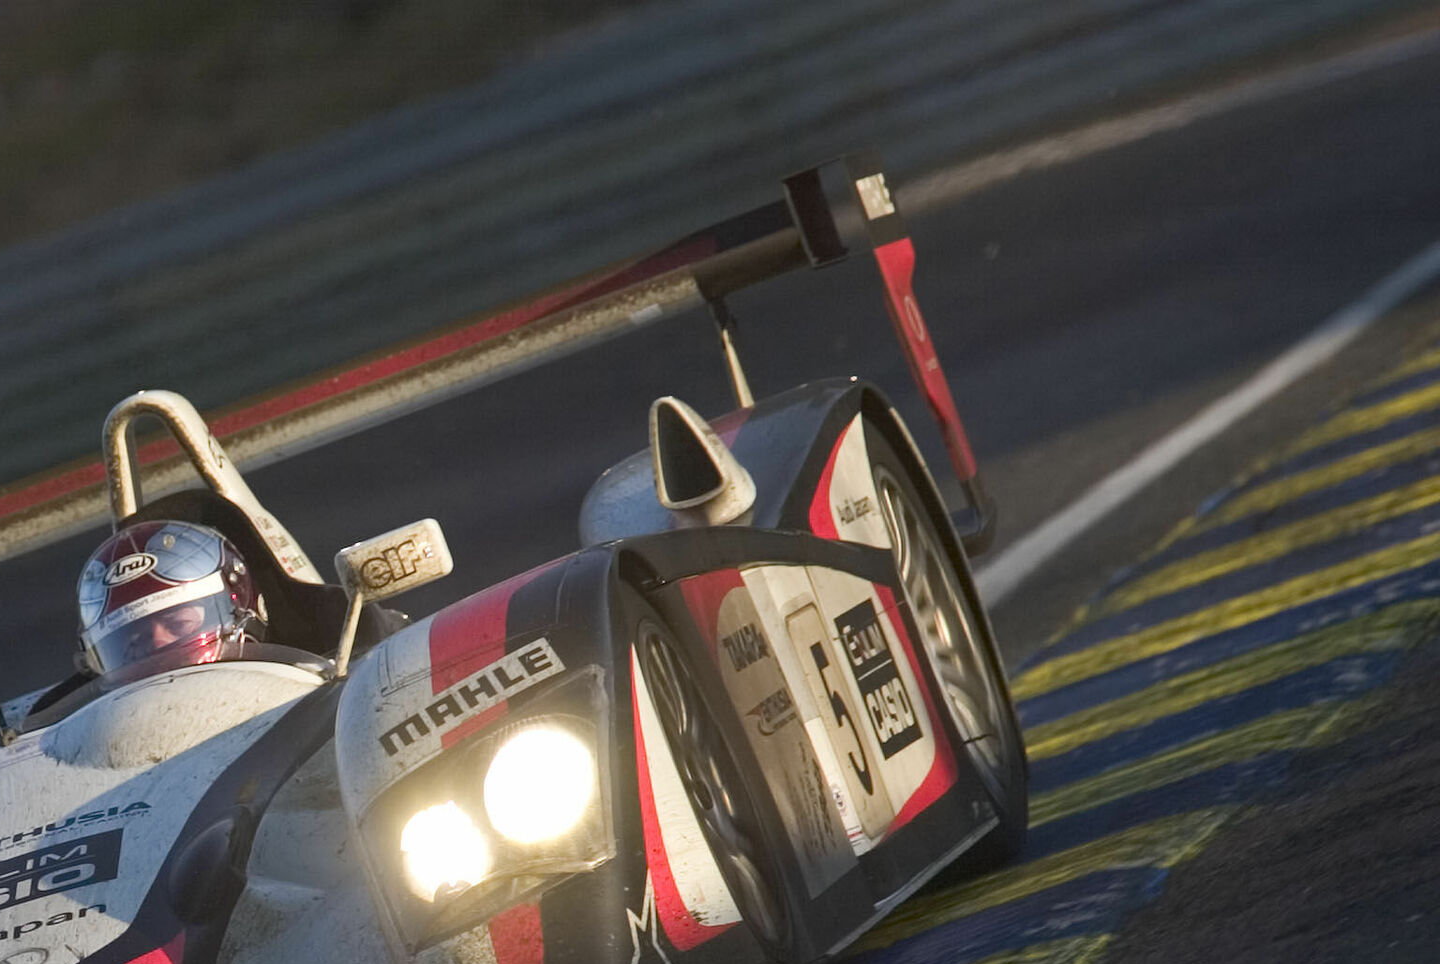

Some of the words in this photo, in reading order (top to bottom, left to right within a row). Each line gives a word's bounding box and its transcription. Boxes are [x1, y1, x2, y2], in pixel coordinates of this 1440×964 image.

[110, 554, 148, 578] Arai
[361, 539, 422, 589] elf
[378, 646, 554, 757] MAHLE
[810, 640, 874, 796] 5
[865, 677, 915, 743] CASIO
